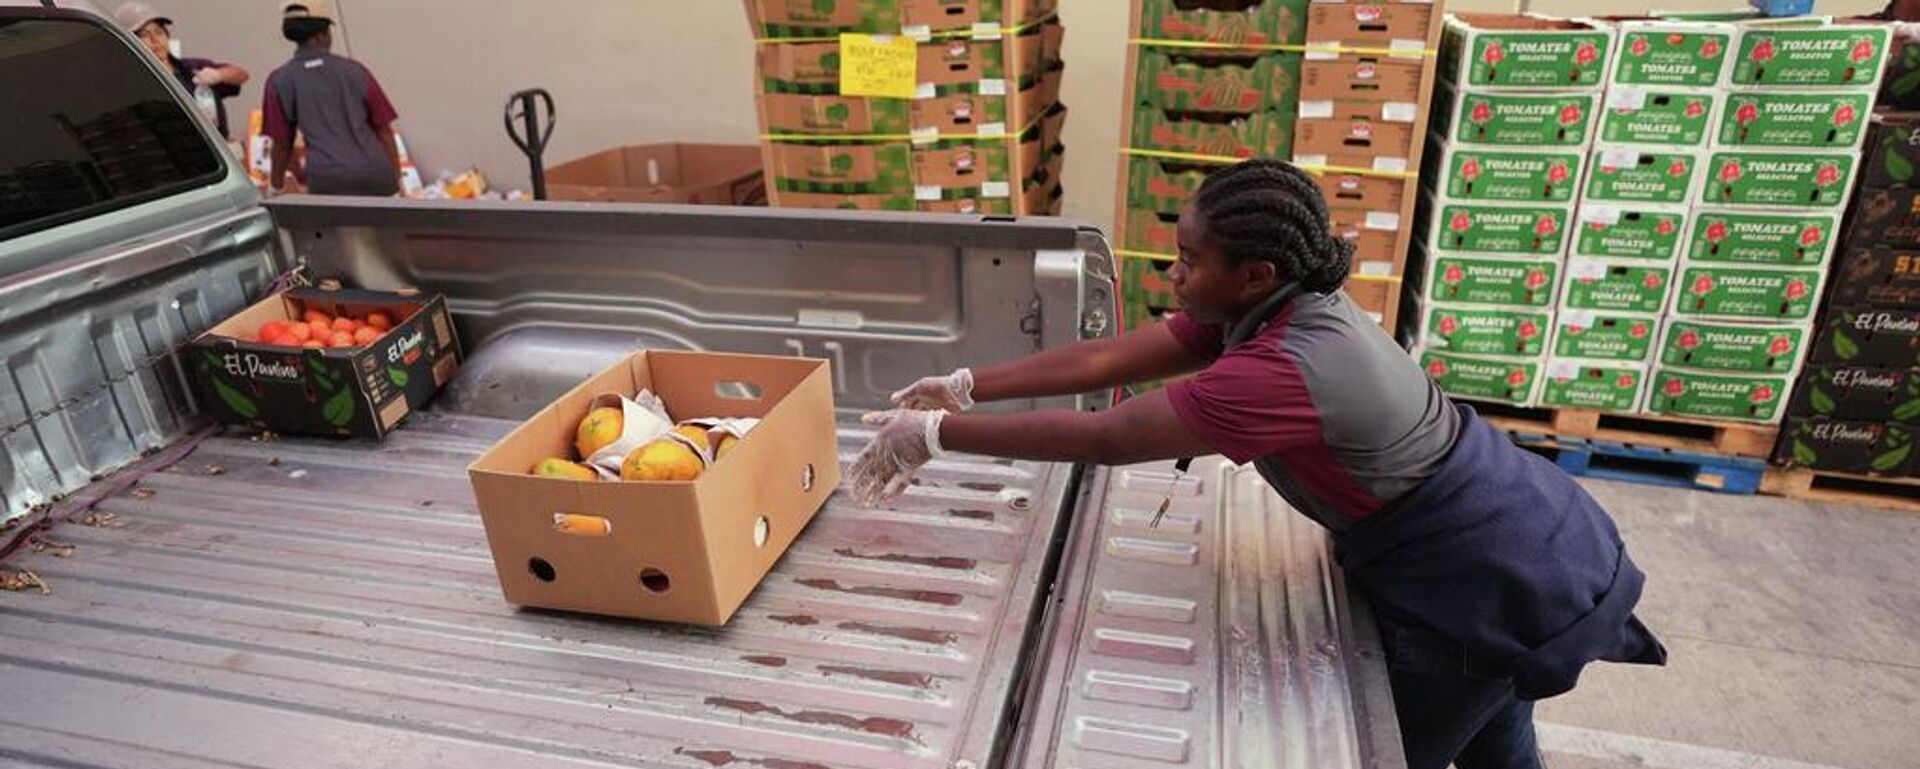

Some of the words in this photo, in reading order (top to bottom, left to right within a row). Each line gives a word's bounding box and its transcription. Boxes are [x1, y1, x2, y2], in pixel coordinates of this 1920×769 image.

[1509, 42, 1570, 52] TOMATES
[1781, 39, 1848, 50] TOMATES
[1641, 64, 1696, 74] TOMATES
[1496, 105, 1555, 115] TOMATES
[1765, 103, 1830, 114] TOMATES
[1627, 123, 1681, 133] TOMATES
[1486, 160, 1544, 171] TOMATES
[1748, 162, 1813, 173] TOMATES
[1476, 214, 1532, 224] TOMATES
[1733, 222, 1797, 234] TOMATES
[1468, 267, 1524, 277] TOMATES
[1720, 276, 1782, 287] TOMATES
[1462, 317, 1514, 328] TOMATES
[1706, 333, 1768, 344] TOMATES
[1690, 381, 1749, 393] TOMATES
